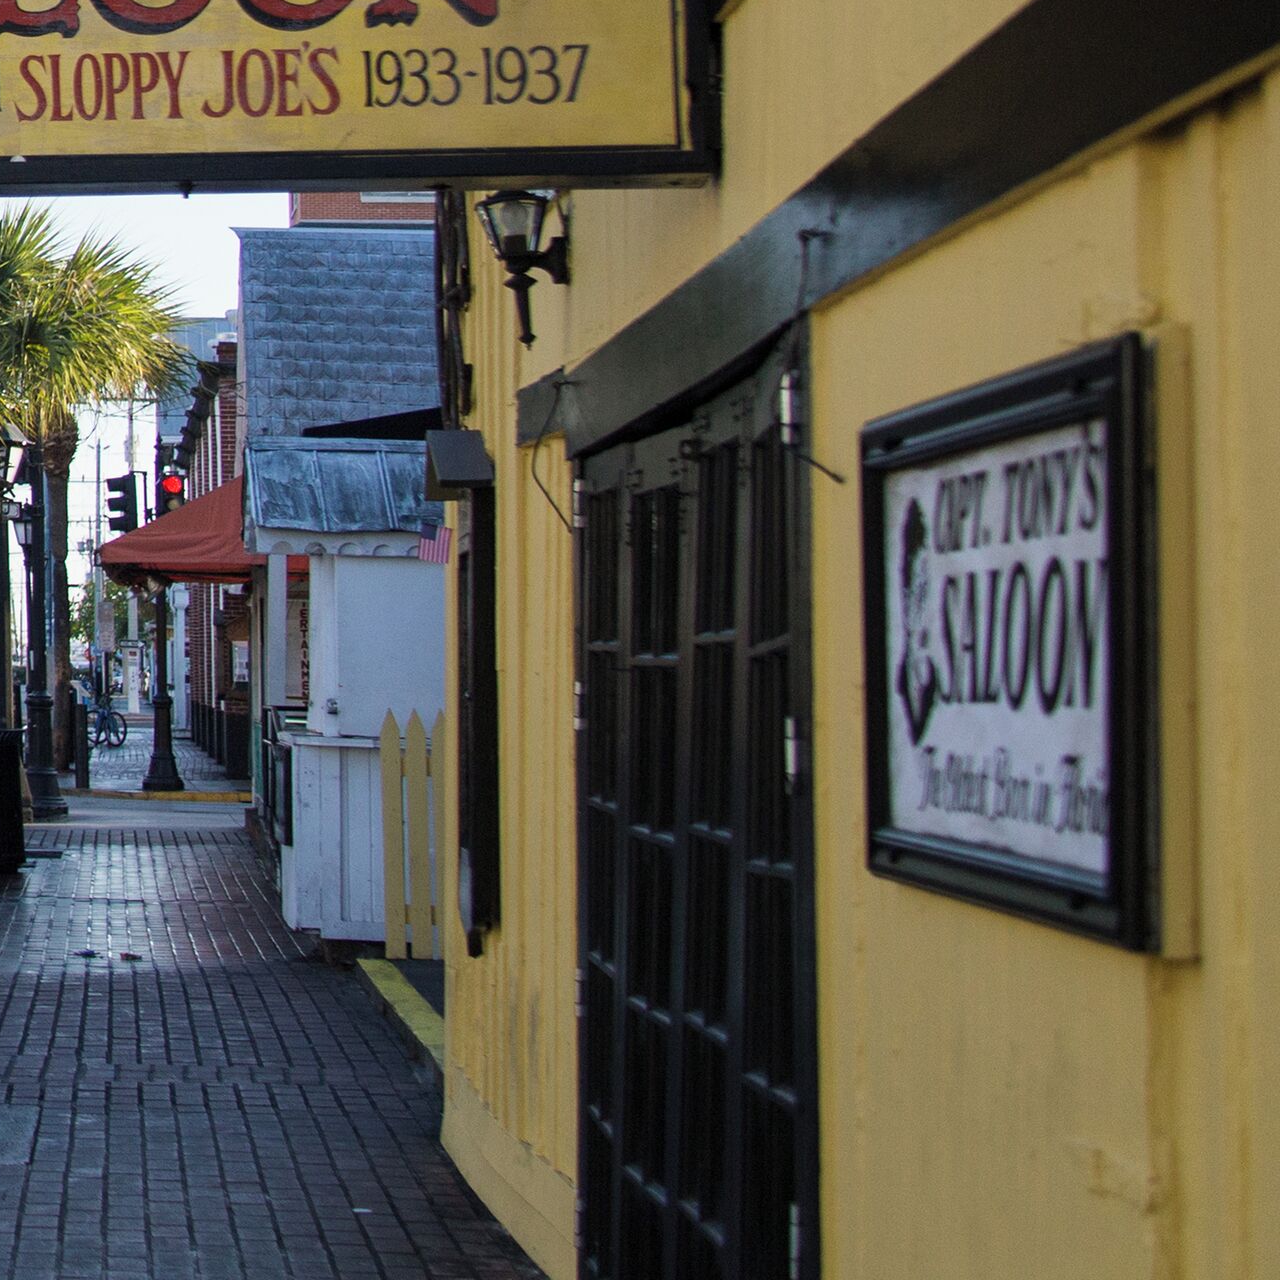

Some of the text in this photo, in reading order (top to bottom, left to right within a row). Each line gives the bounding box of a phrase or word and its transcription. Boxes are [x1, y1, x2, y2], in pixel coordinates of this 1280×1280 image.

[14, 50, 189, 122] SLOPPY
[201, 40, 341, 118] JOE'S
[361, 43, 591, 108] 1933-1937
[940, 554, 1108, 716] SALOON
